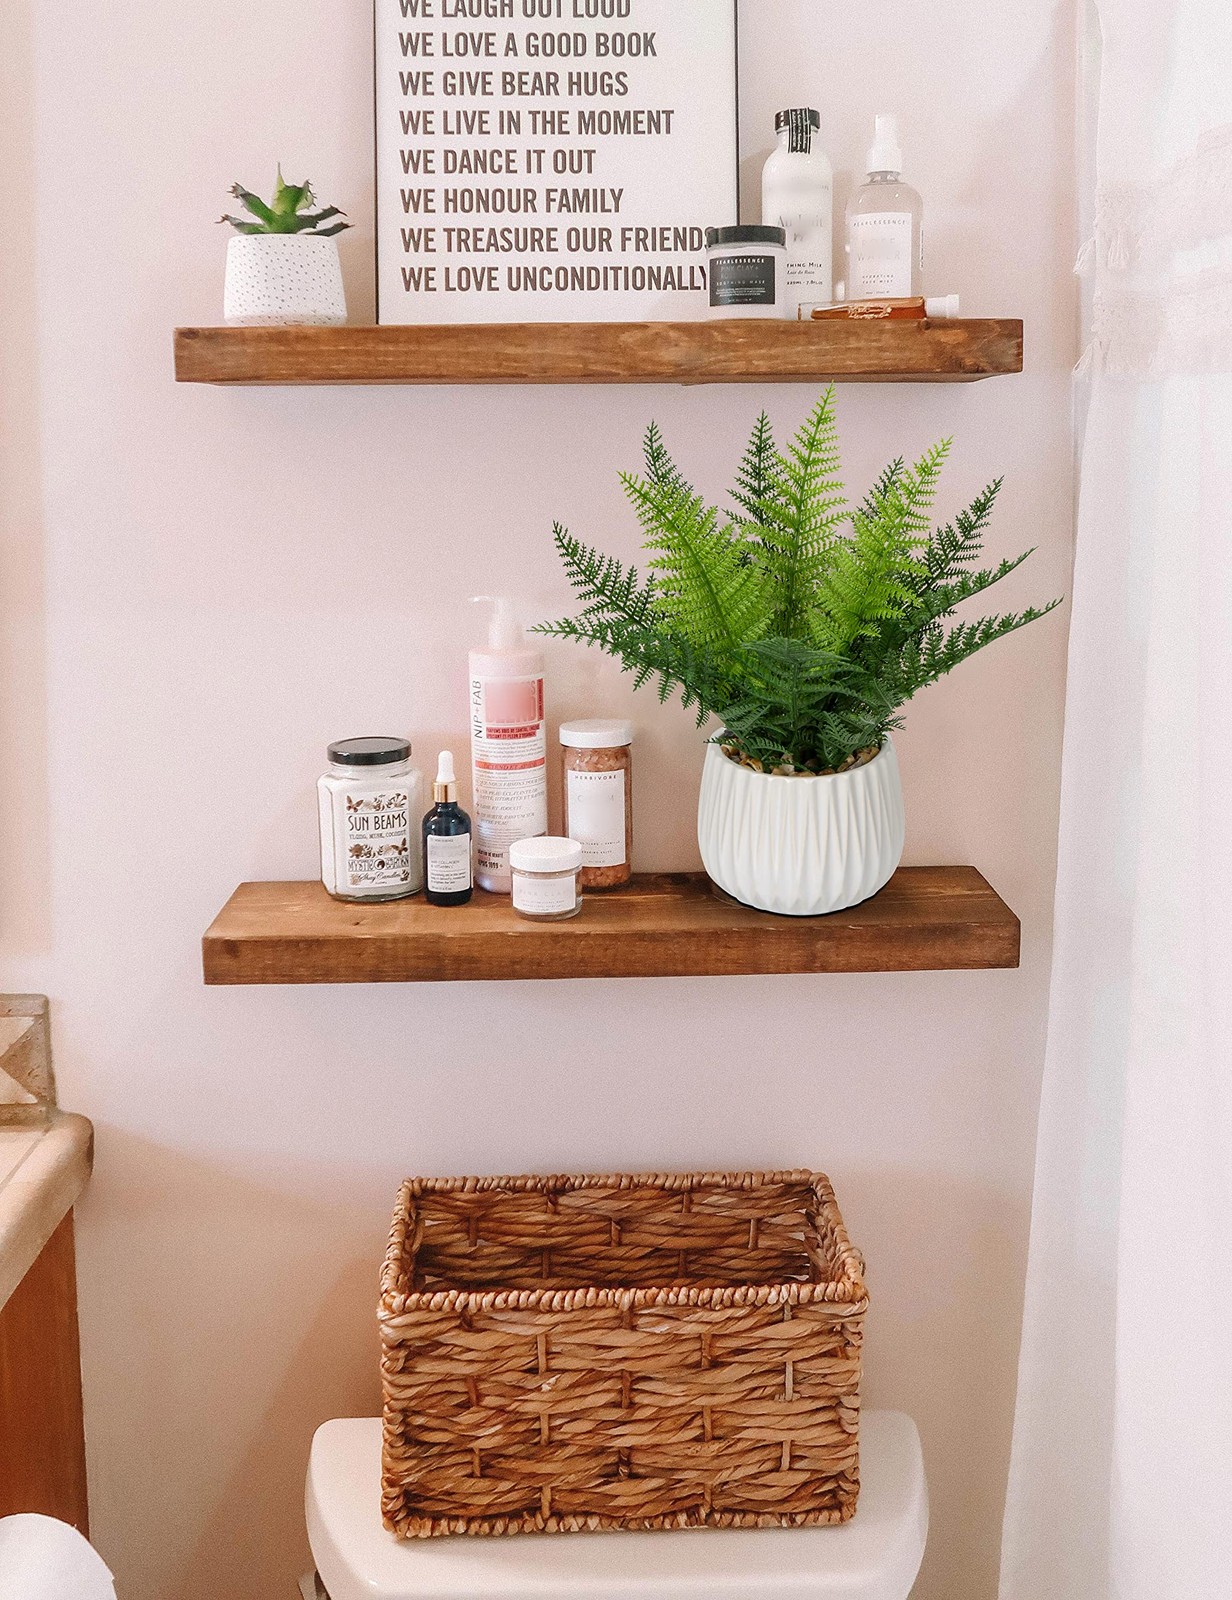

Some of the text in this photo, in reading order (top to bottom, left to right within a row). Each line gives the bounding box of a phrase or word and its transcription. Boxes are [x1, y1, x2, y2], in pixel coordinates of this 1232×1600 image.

[400, 0, 630, 18] WE LAUGH OUT LOUD
[399, 32, 656, 57] WE LOVE A GOOD BOOK
[399, 72, 628, 96] WE GIVE BEAR HUGS
[400, 110, 674, 135] WE LIVE IN THE MOMENT
[400, 149, 596, 174] WE DANCE IT OUT
[400, 189, 623, 213] WE HONOUR FAMILY
[401, 227, 709, 252] WE TREASURE OUR FRIEND
[401, 267, 436, 291] WE
[445, 267, 499, 291] LOVE
[348, 811, 408, 832] SUN BEAMS
